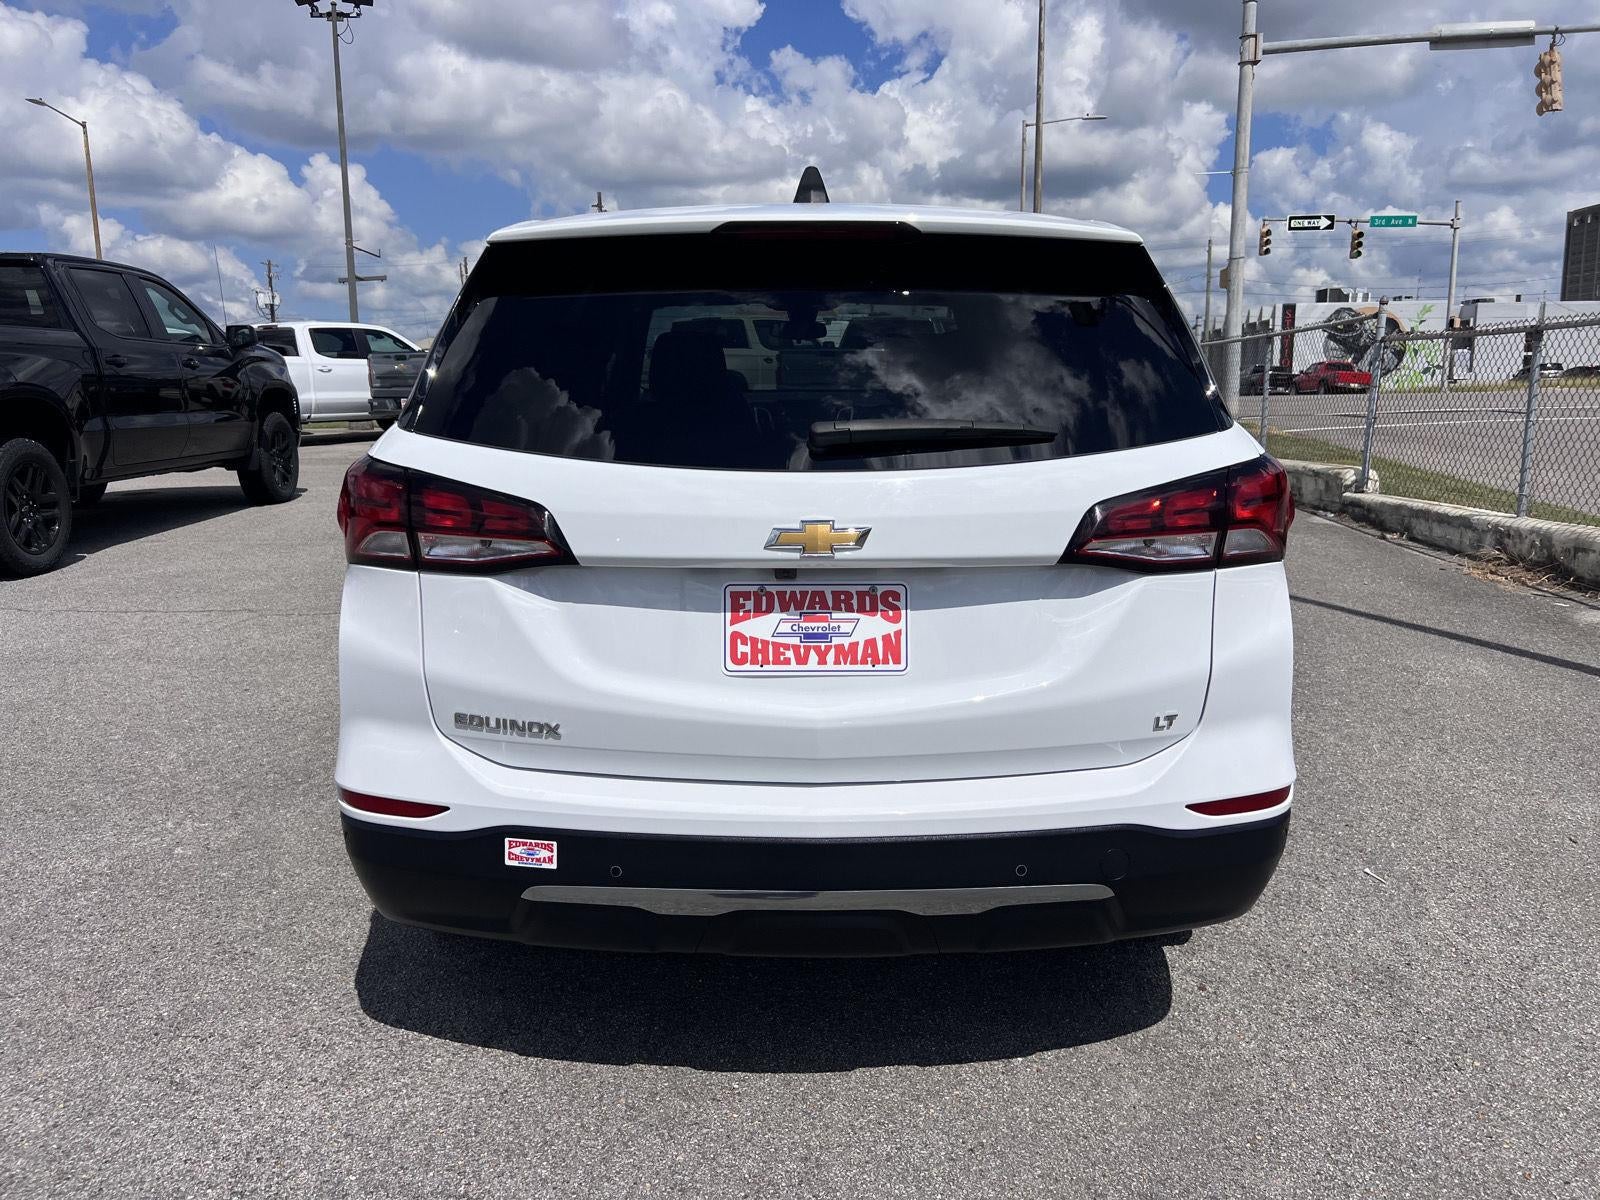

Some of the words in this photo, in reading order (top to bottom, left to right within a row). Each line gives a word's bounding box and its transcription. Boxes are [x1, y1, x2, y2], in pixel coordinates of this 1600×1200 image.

[1293, 219, 1305, 227] ONE
[729, 589, 902, 627] EDWARDS
[790, 623, 841, 632] Chevrolet
[729, 628, 902, 666] CHEVYMAN
[454, 712, 562, 740] EQUINOX
[1152, 714, 1178, 732] LT
[508, 839, 554, 853] EDWARDS
[508, 850, 554, 865] CHEVYMAN
